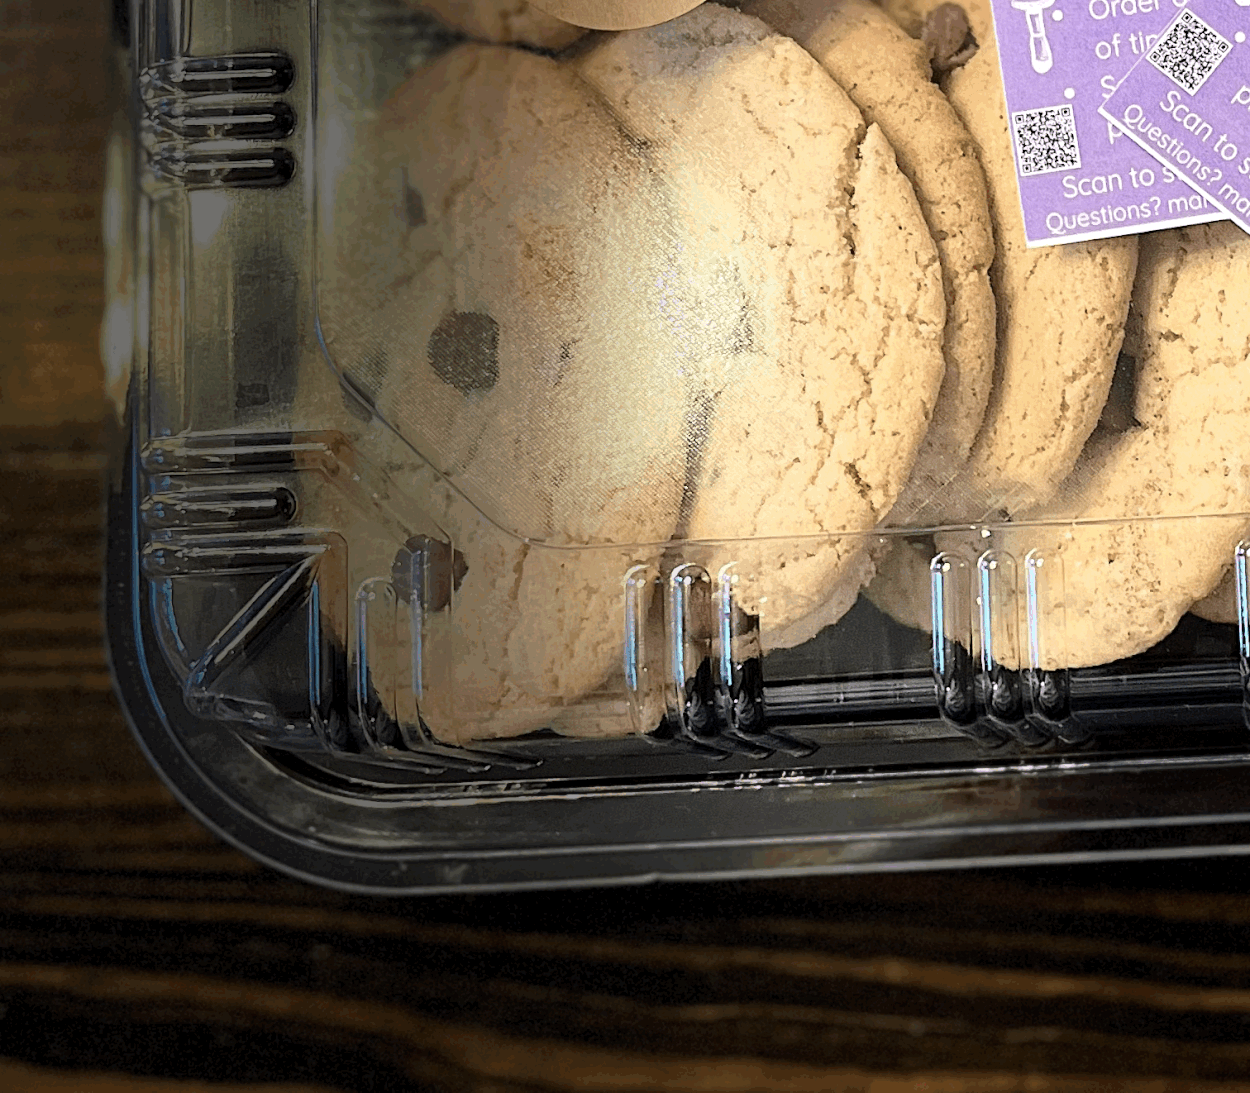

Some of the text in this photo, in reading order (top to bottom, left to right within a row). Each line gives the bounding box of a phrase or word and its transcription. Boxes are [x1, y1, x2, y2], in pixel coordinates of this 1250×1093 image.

[1094, 32, 1122, 60] of
[1121, 103, 1223, 186] Questions?
[1159, 90, 1214, 143] Scan
[1213, 133, 1239, 163] to
[1061, 172, 1123, 199] Scan
[1128, 167, 1155, 189] to
[1045, 195, 1162, 235] Questions?
